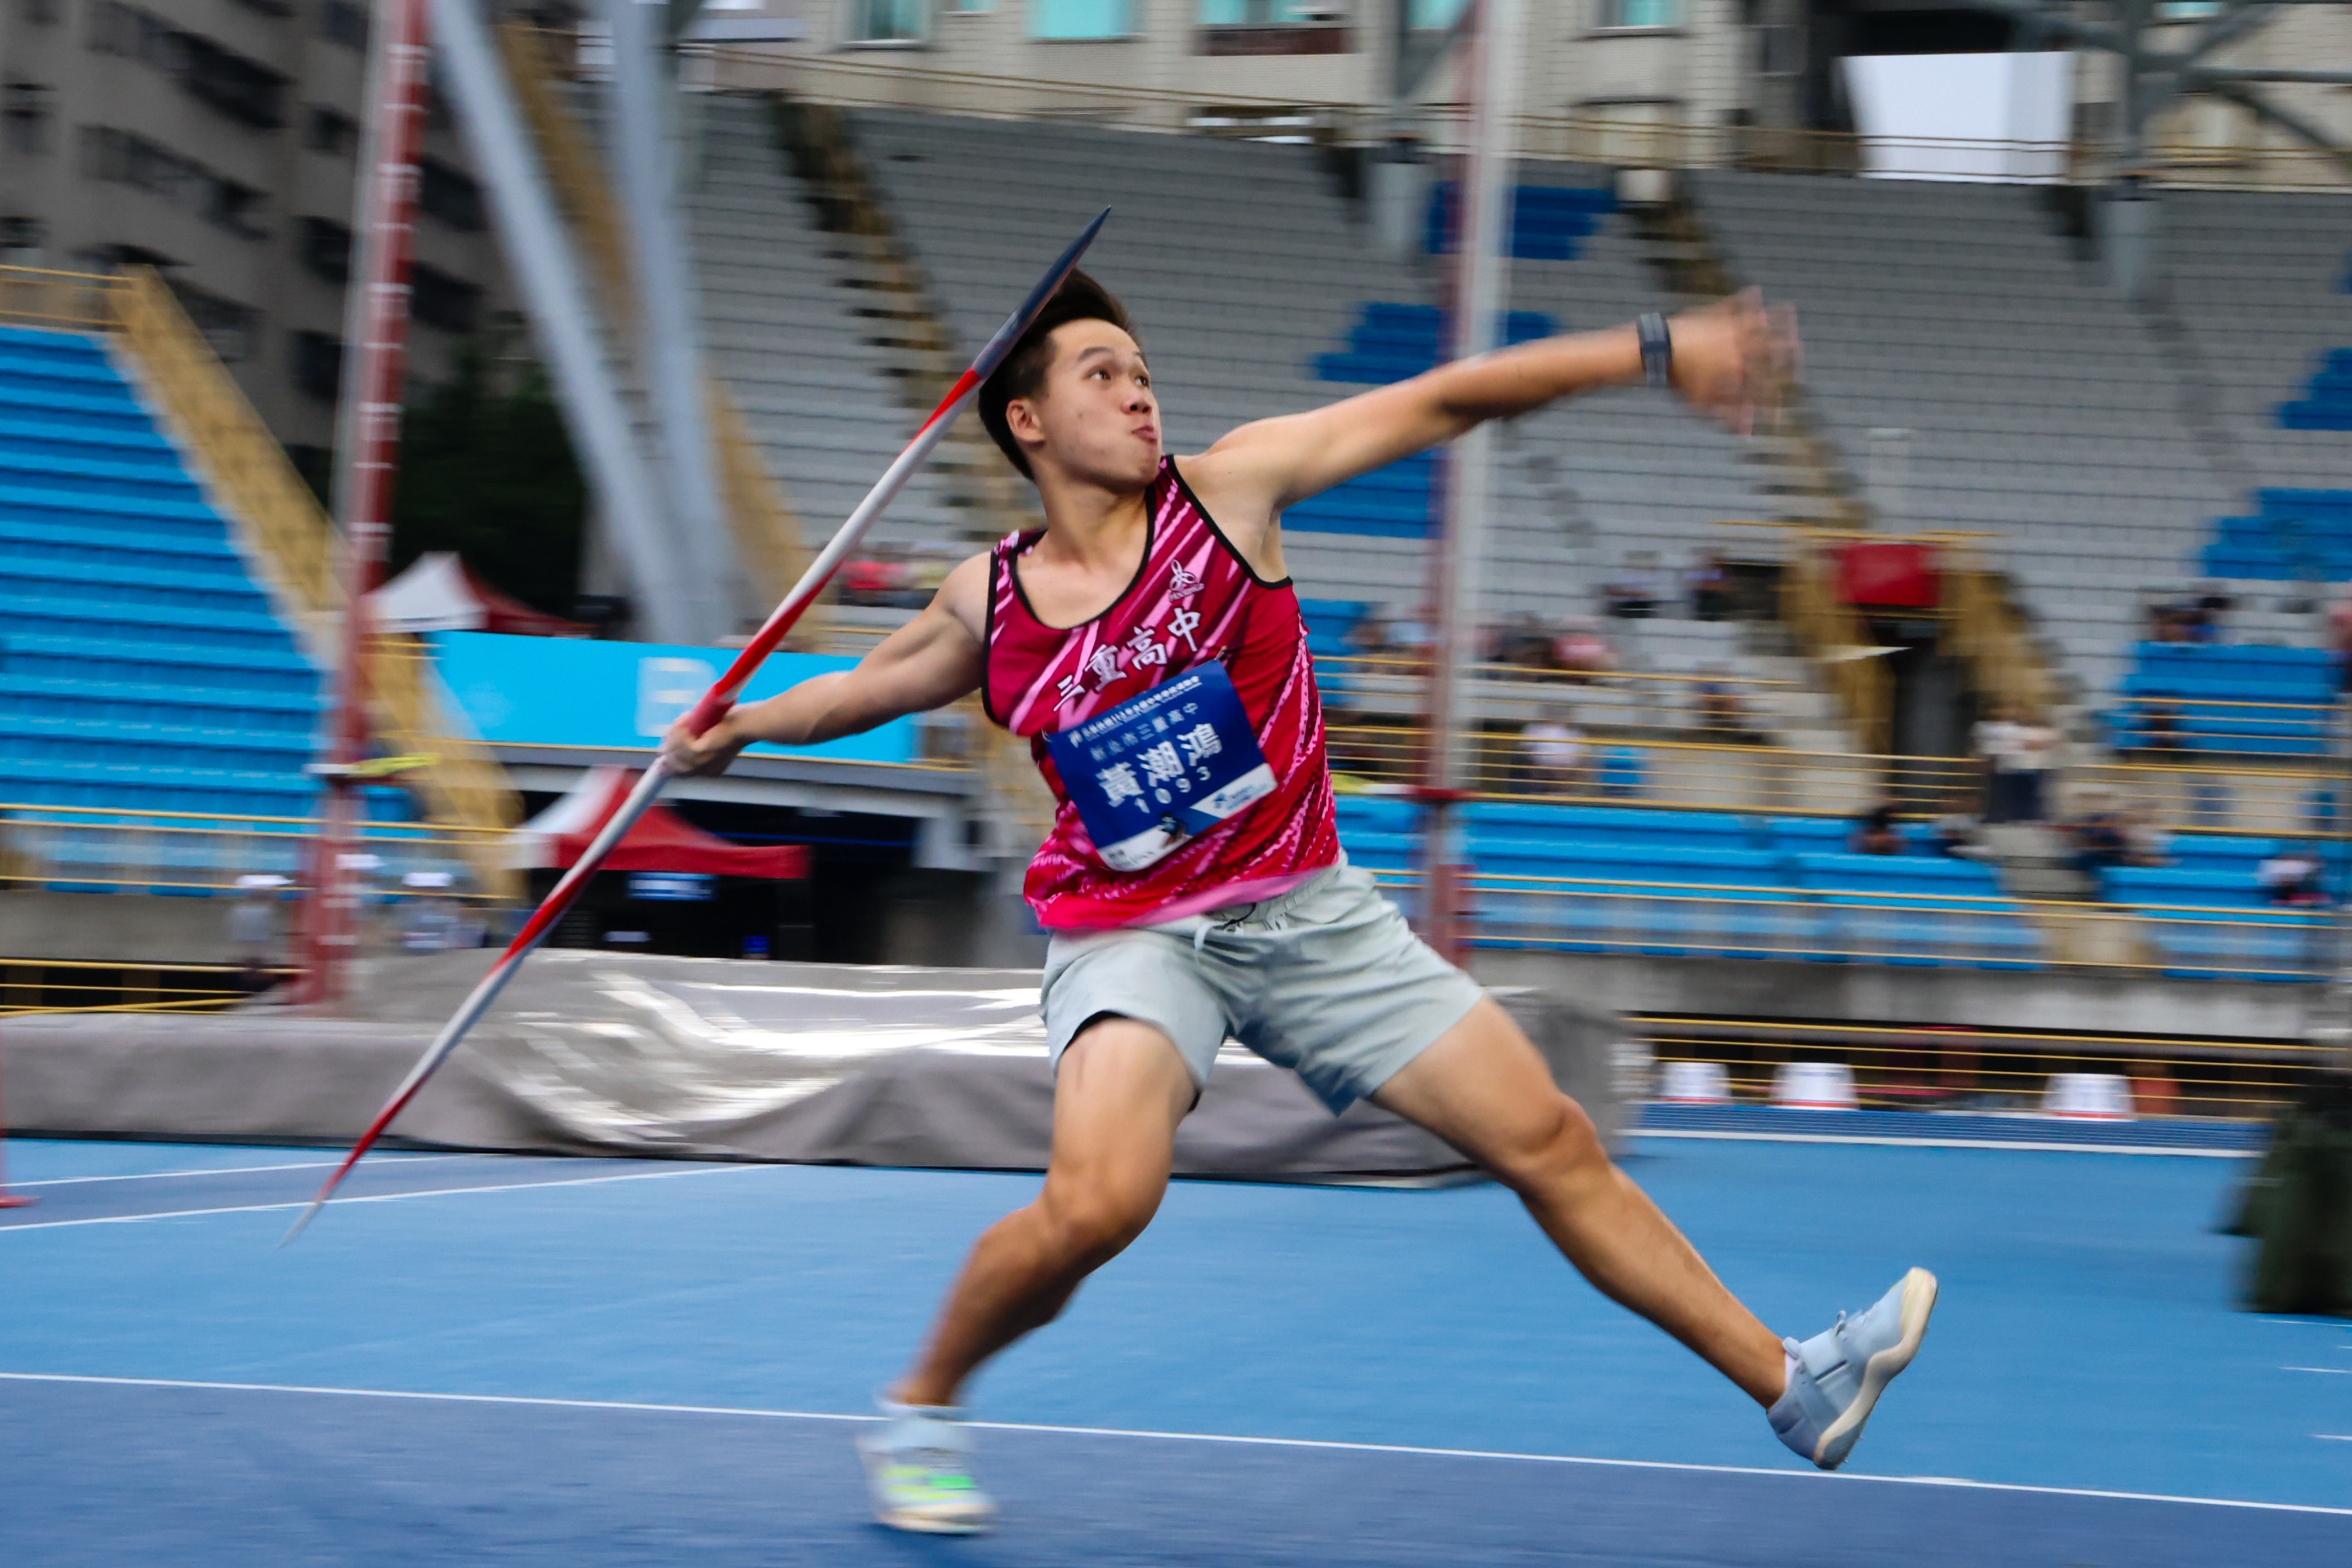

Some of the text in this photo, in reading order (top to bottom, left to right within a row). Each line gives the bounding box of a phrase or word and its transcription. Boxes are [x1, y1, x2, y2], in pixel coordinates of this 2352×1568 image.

[1053, 608, 1201, 712] 三重高中
[1134, 766, 1211, 814] 1093
